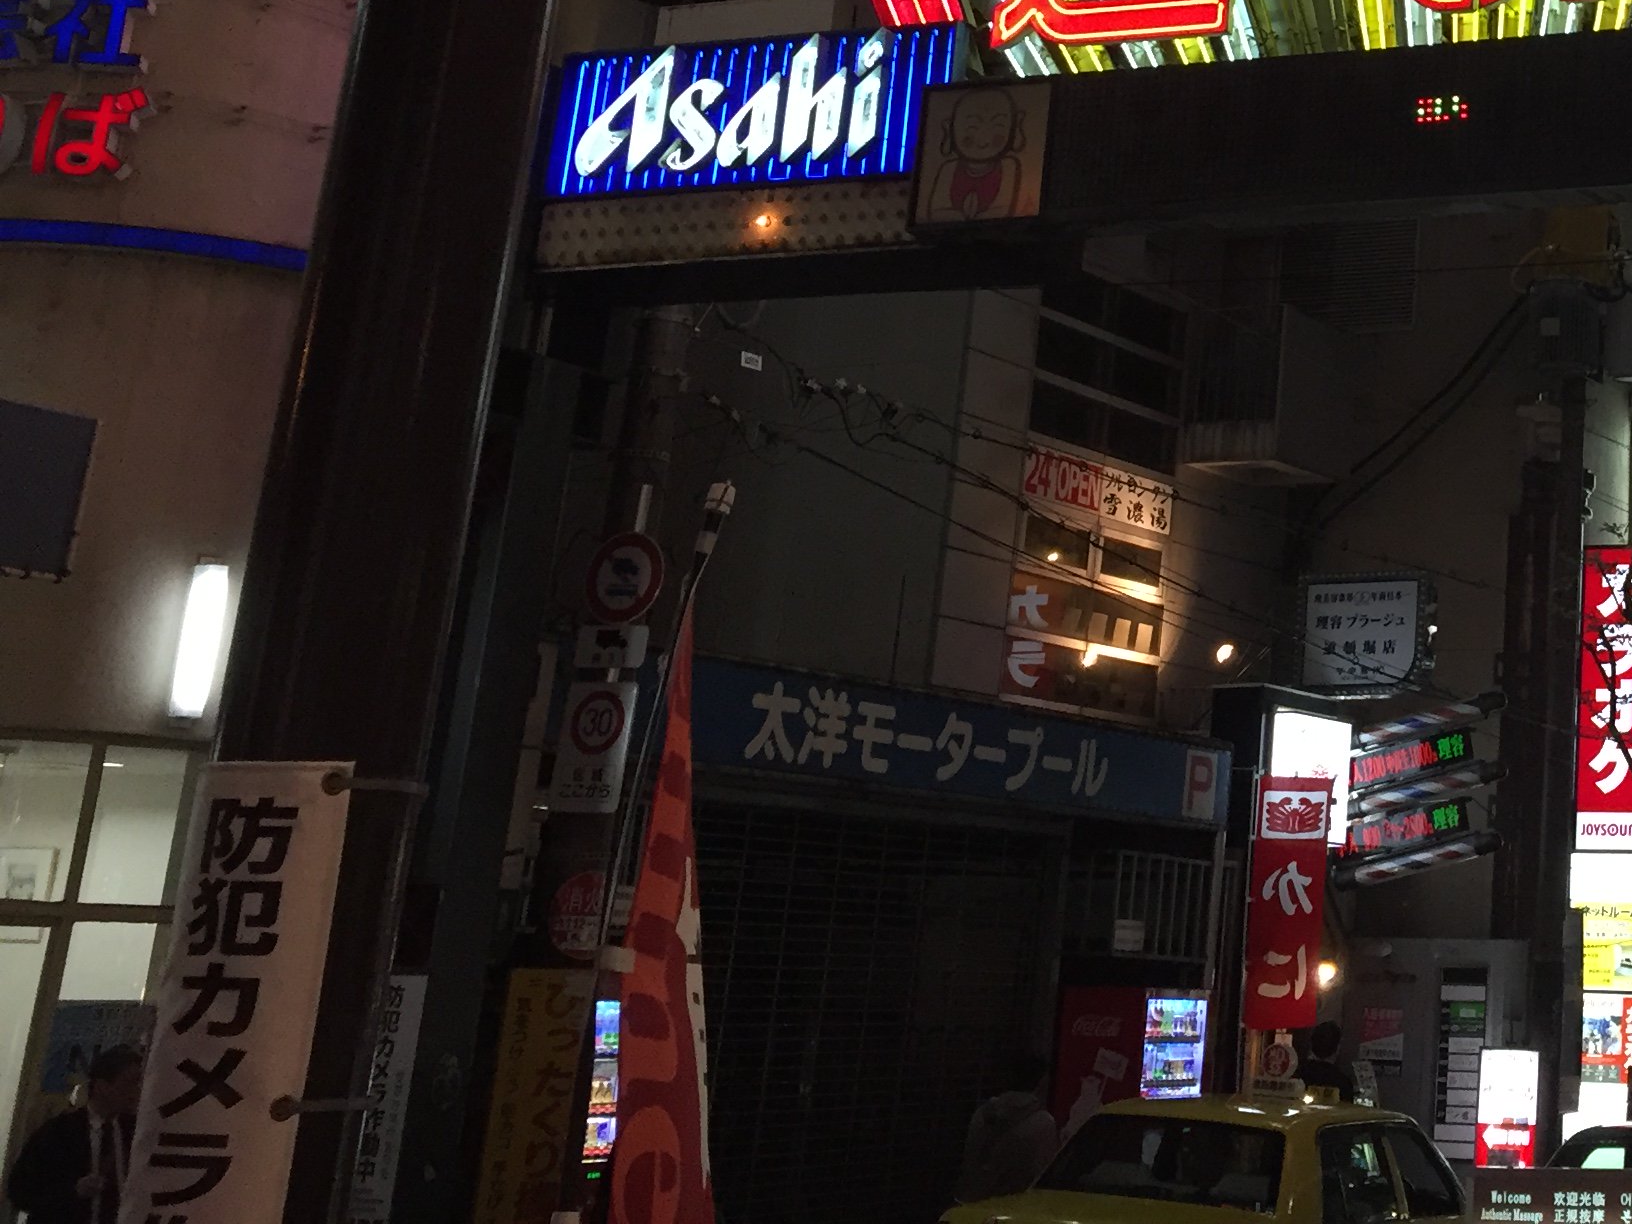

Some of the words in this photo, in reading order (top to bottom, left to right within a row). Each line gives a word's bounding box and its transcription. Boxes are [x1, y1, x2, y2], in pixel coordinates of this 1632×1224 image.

[574, 27, 892, 176] Asahi
[0, 88, 150, 176] ば
[1057, 460, 1100, 510] OPEN
[581, 707, 615, 738] 30
[743, 680, 1111, 797] 太洋モータープール
[558, 782, 611, 799] ここから
[1188, 753, 1214, 812] P
[142, 796, 300, 1224] 防犯カメラ
[1490, 1190, 1532, 1205] Welcome
